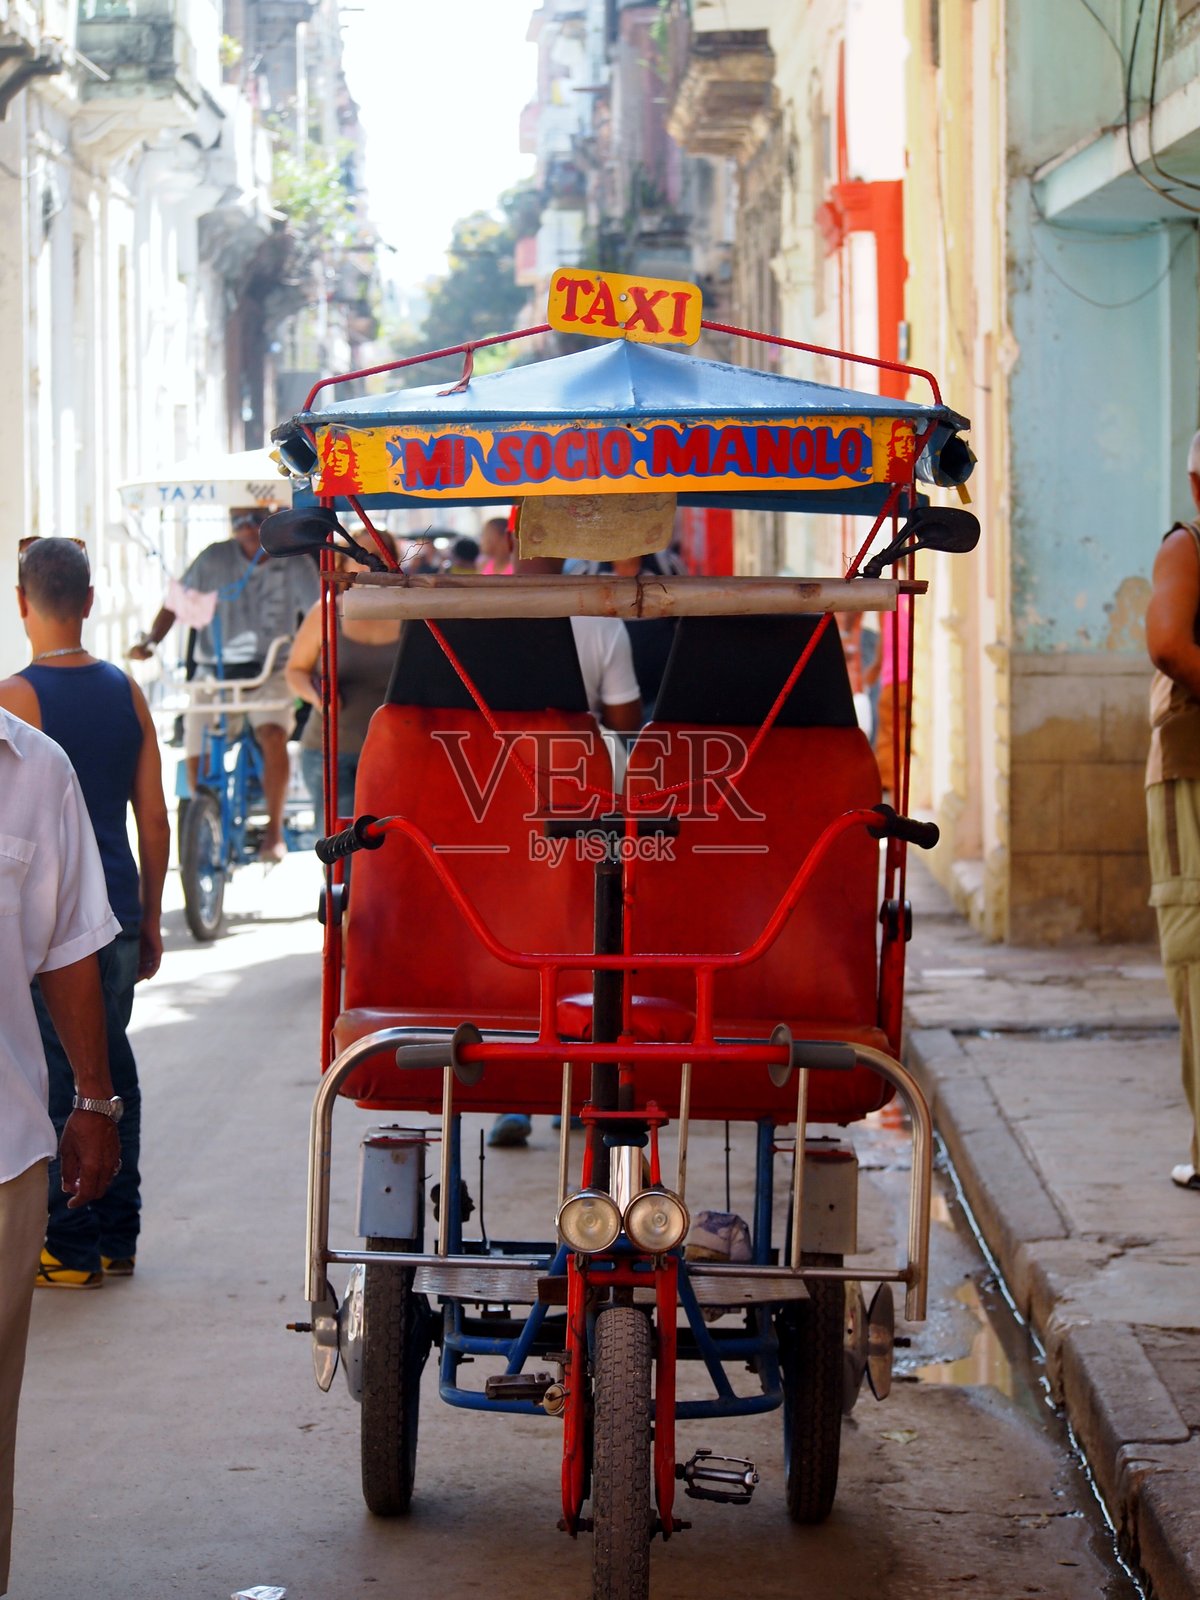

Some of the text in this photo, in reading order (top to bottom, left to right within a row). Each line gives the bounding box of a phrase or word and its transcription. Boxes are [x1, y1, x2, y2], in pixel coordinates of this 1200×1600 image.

[556, 277, 692, 337] TAXI
[405, 427, 863, 488] MI SOCIO MANOLO
[158, 484, 215, 501] TAXI
